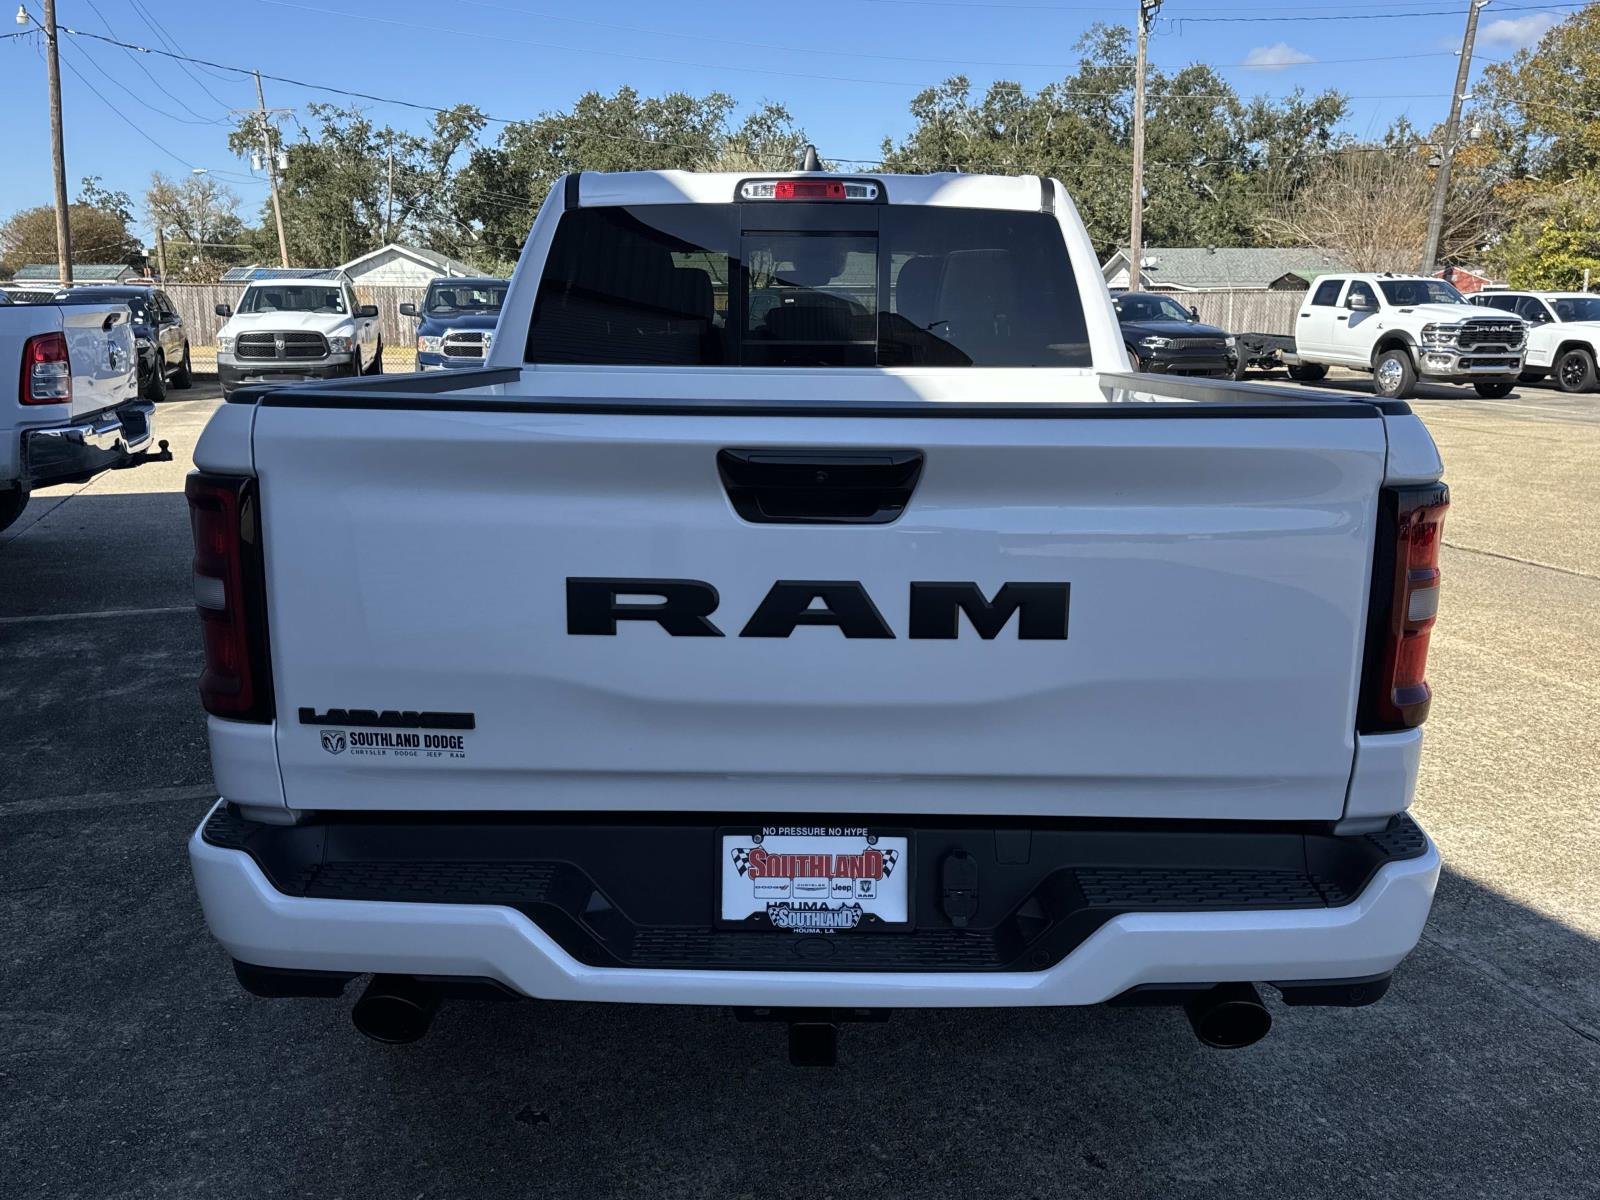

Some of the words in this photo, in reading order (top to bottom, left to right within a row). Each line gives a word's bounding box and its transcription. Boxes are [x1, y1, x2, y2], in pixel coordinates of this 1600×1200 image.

[566, 576, 1071, 640] RAM
[298, 706, 476, 729] LARAM
[350, 731, 420, 748] SOUTHLAND
[424, 735, 464, 750] DODGE
[762, 827, 776, 836] NO
[778, 827, 826, 836] PRESSURE
[828, 827, 842, 836] NO
[844, 827, 868, 836] HYPE
[748, 848, 883, 881] SOUTHLAND
[832, 883, 852, 892] Jeep
[777, 908, 853, 928] SOUTHLAND
